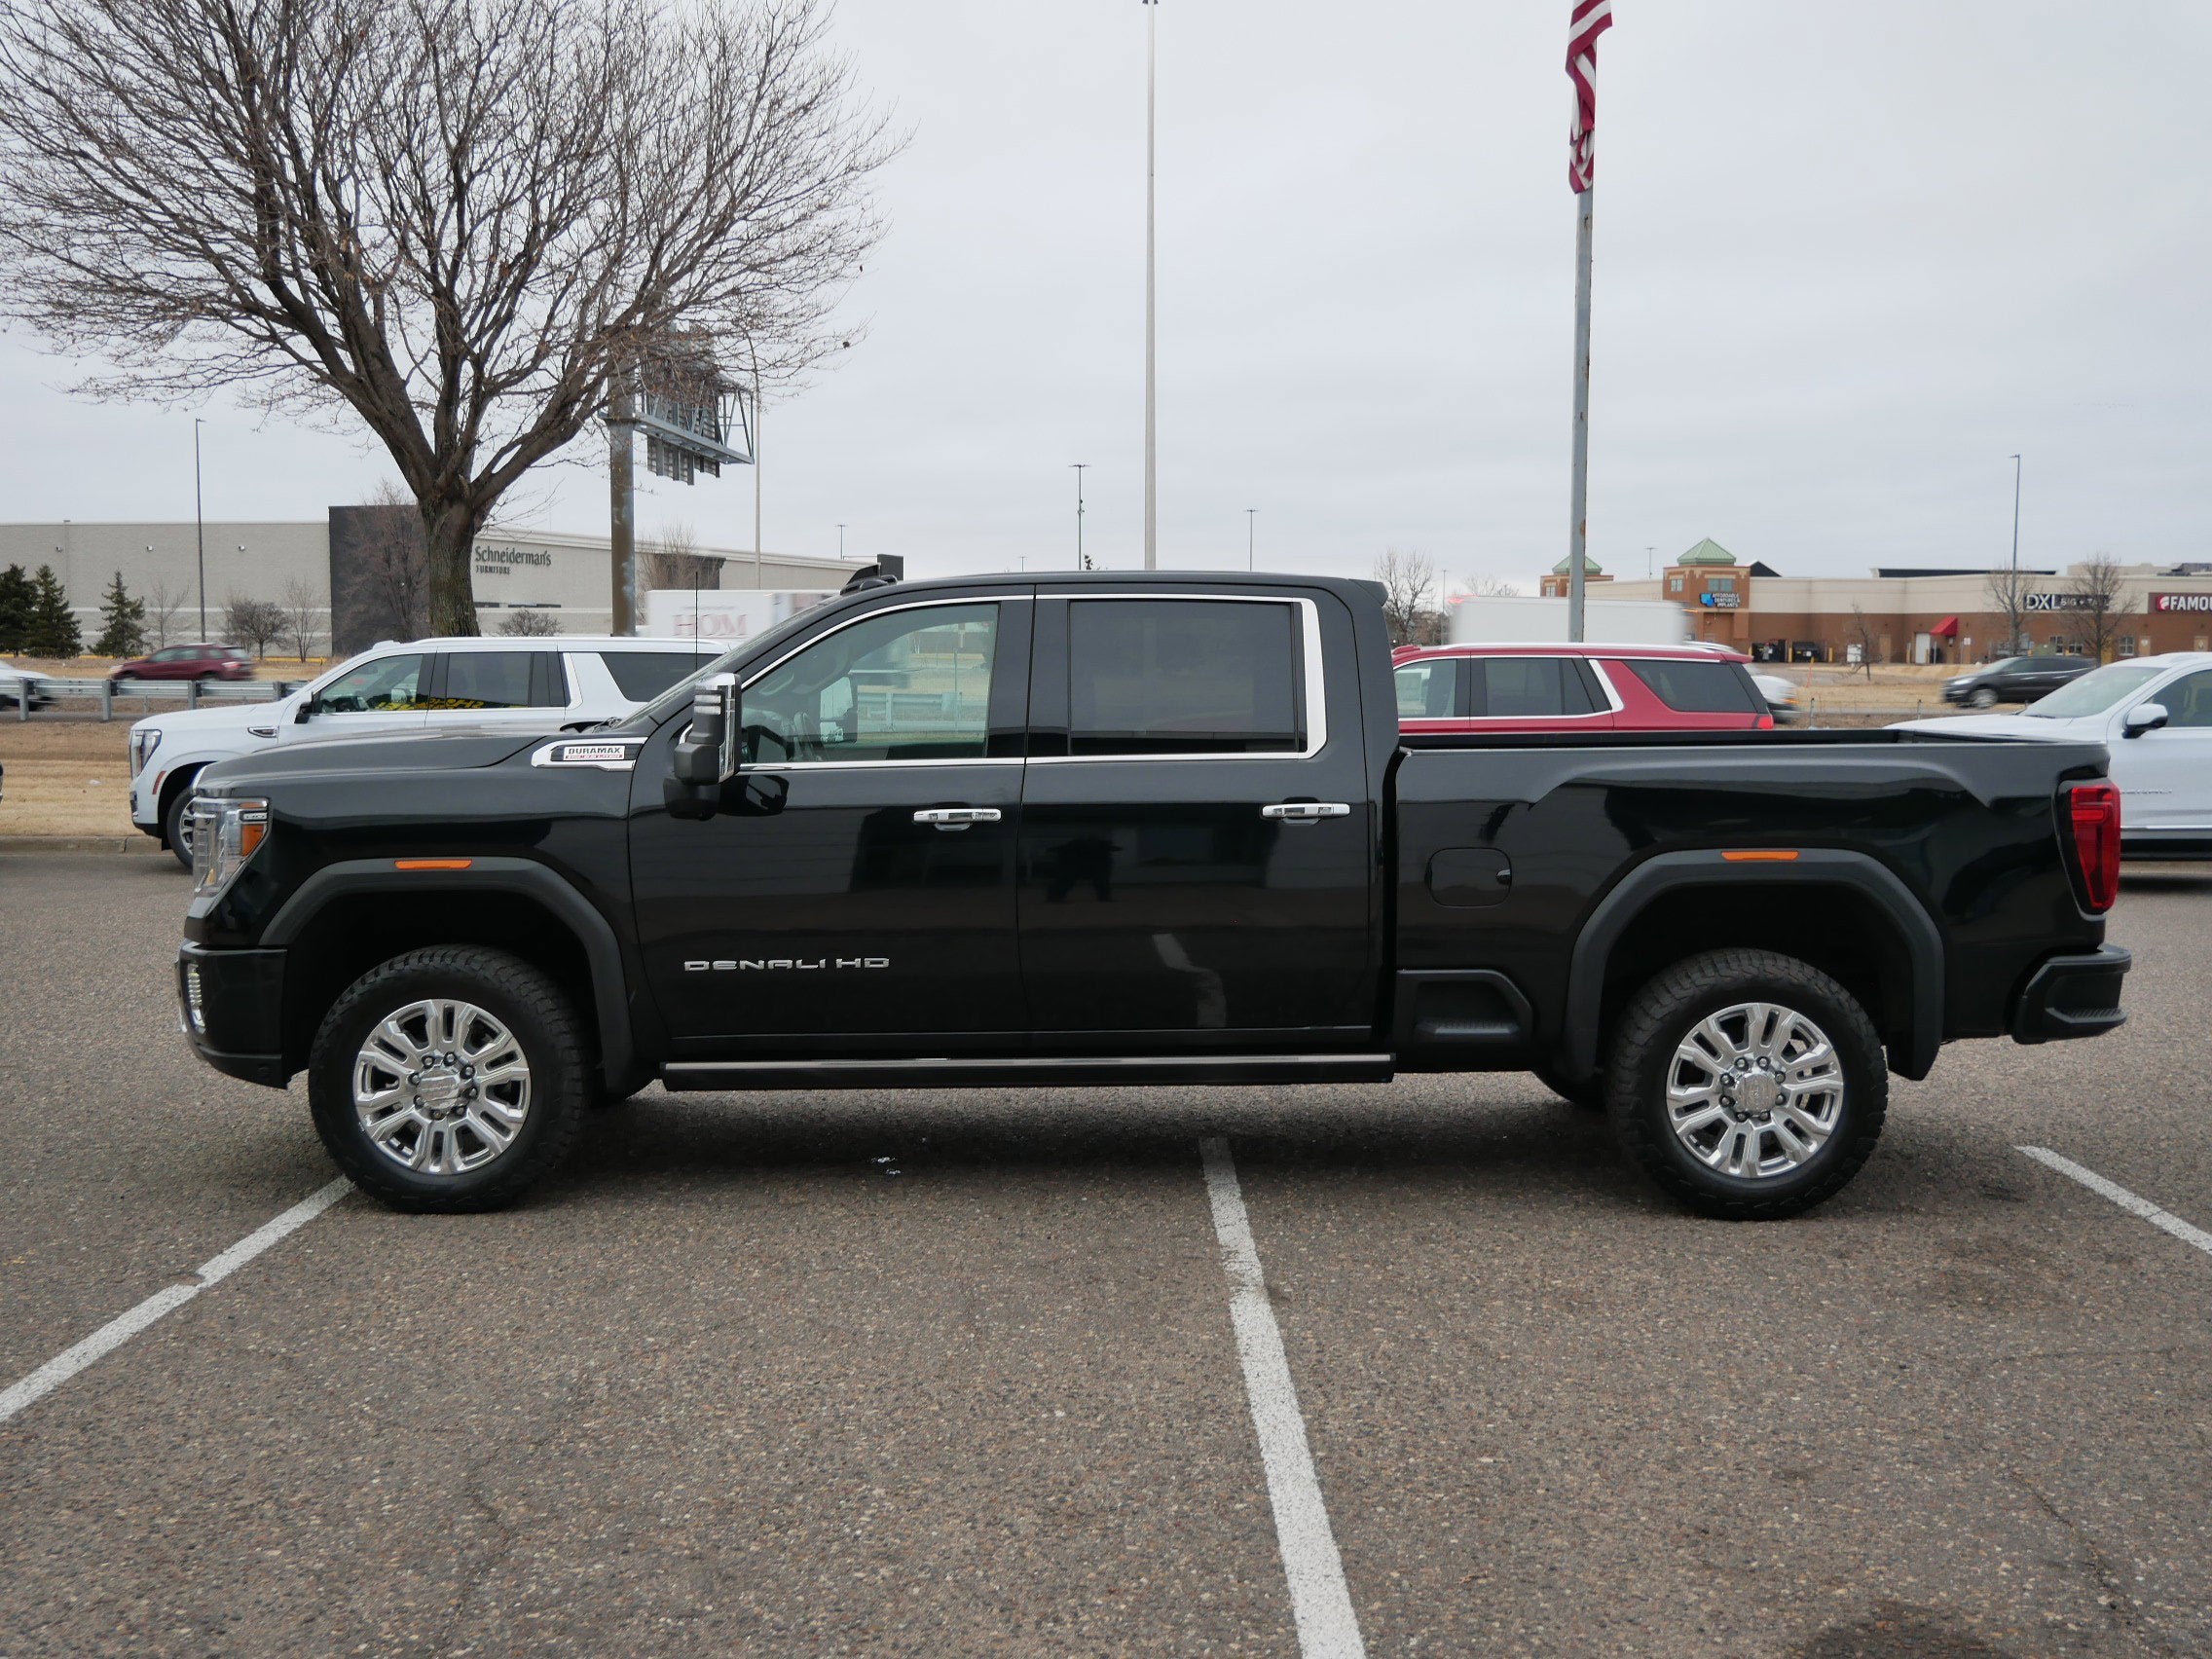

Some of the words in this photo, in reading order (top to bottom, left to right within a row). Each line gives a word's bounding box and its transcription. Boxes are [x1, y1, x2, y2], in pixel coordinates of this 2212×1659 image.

[475, 546, 552, 567] Schneiderman's
[475, 565, 511, 575] FURNITURE
[2026, 594, 2061, 609] DXL
[2087, 598, 2109, 607] TAL
[2170, 596, 2212, 611] FAMO
[684, 959, 826, 971] DENALI
[836, 958, 890, 968] HD
